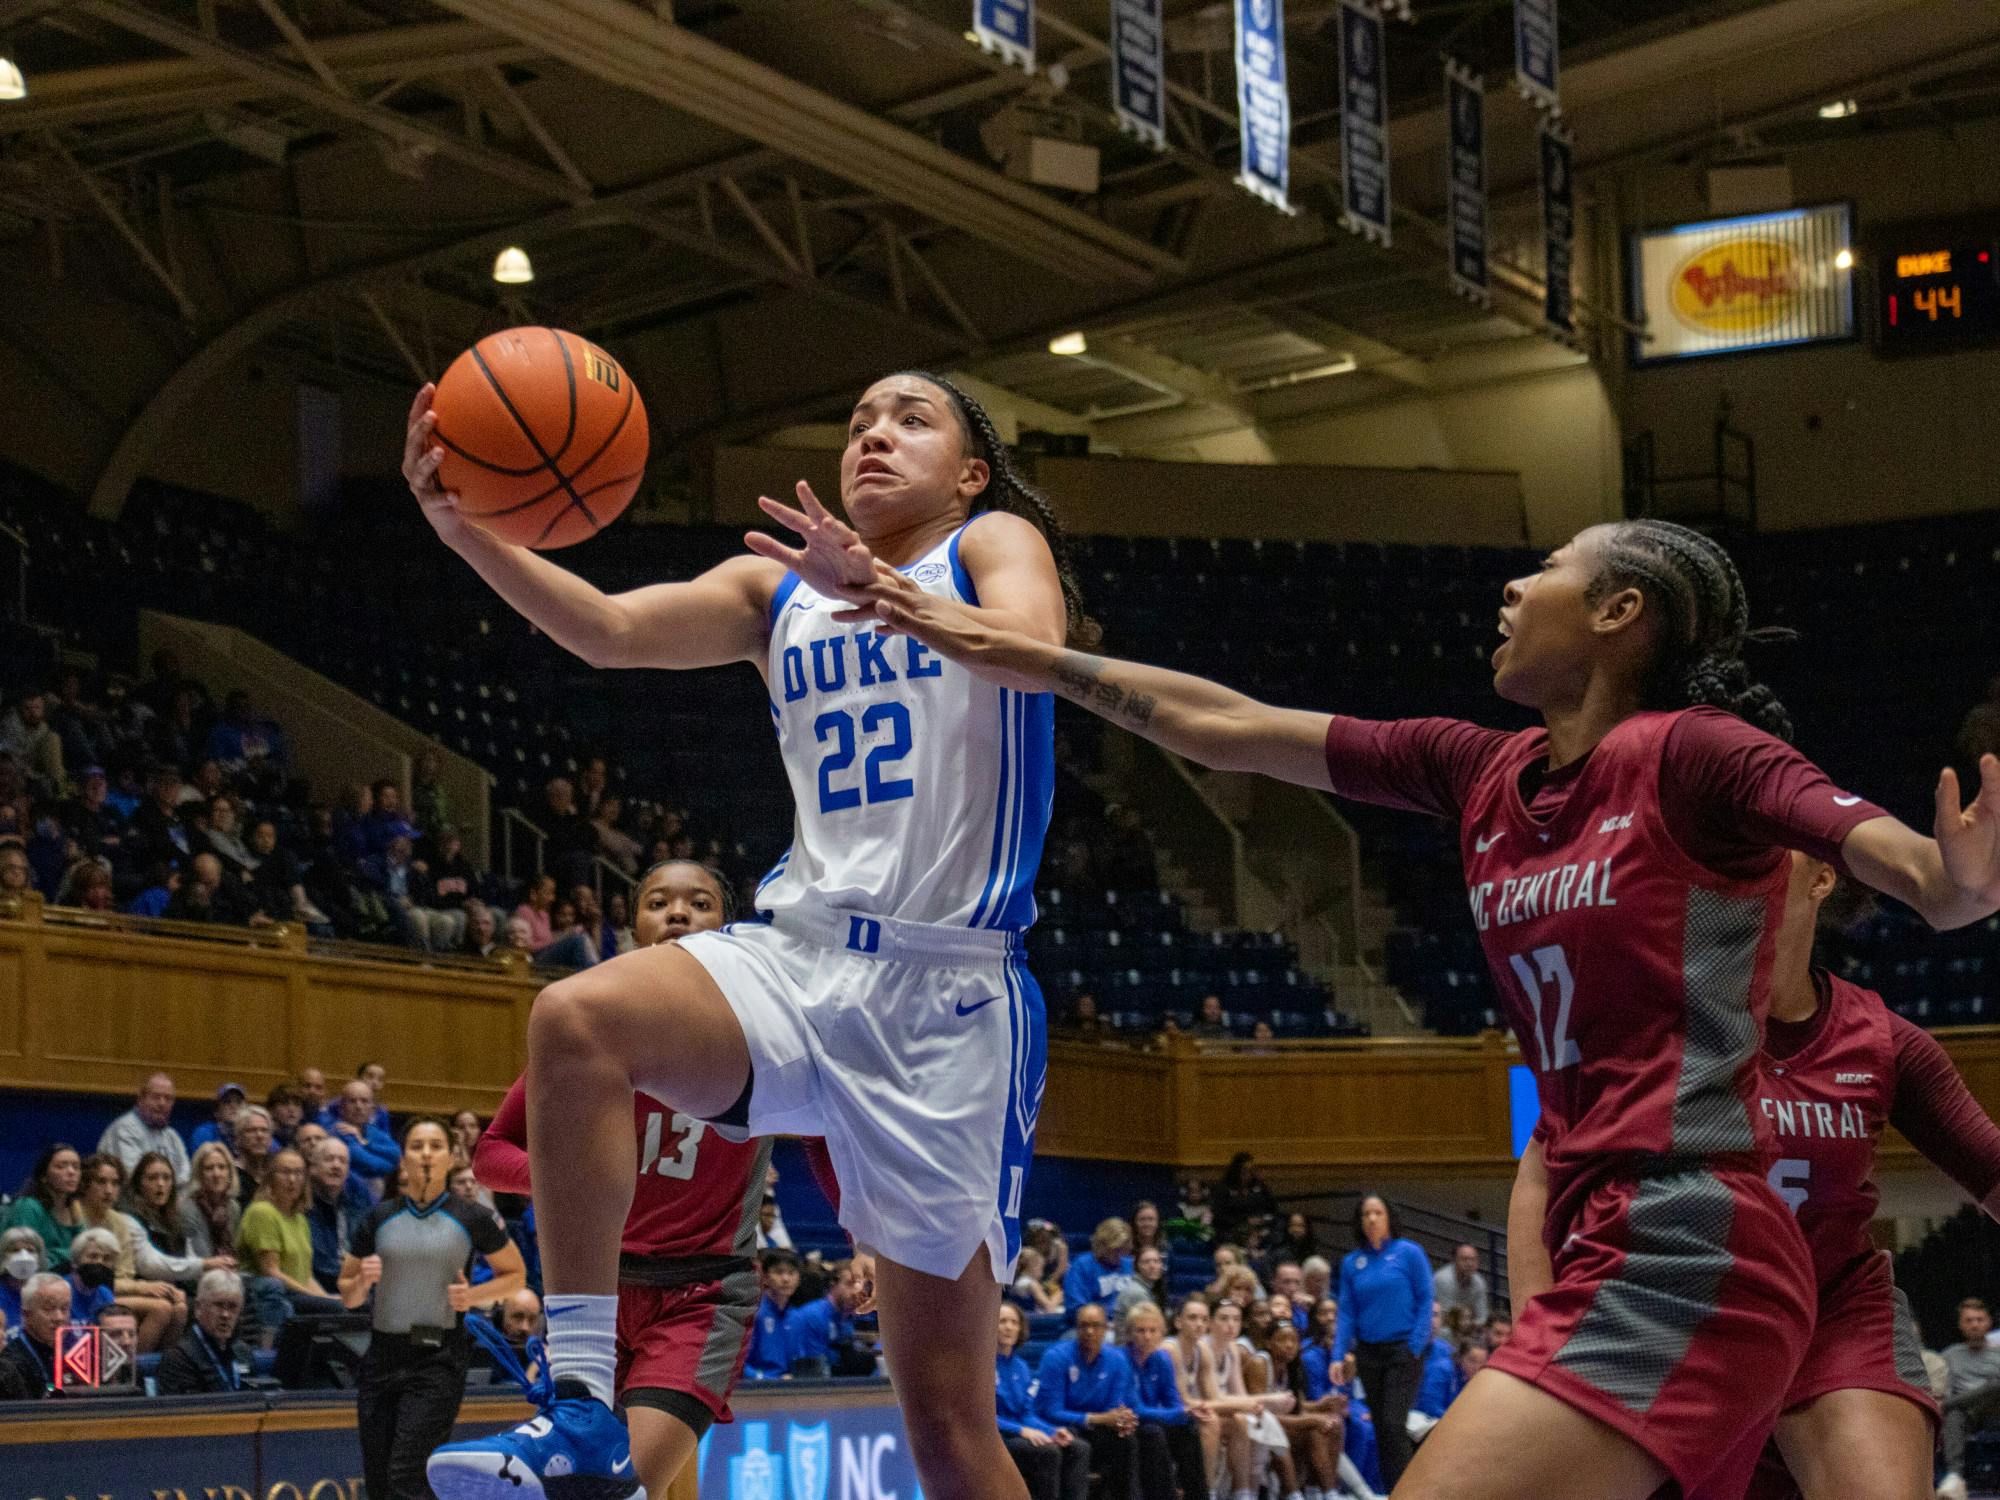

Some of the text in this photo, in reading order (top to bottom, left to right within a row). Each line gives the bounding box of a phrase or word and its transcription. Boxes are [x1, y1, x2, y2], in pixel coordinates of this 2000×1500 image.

[1913, 286, 1961, 321] 44
[783, 632, 942, 702] DUKE
[813, 701, 914, 814] 22
[1497, 857, 1617, 926] CENTRAL
[1509, 944, 1582, 1072] 12
[1835, 1072, 1873, 1084] MEAC
[640, 1112, 708, 1180] 13
[840, 1433, 896, 1500] NC
